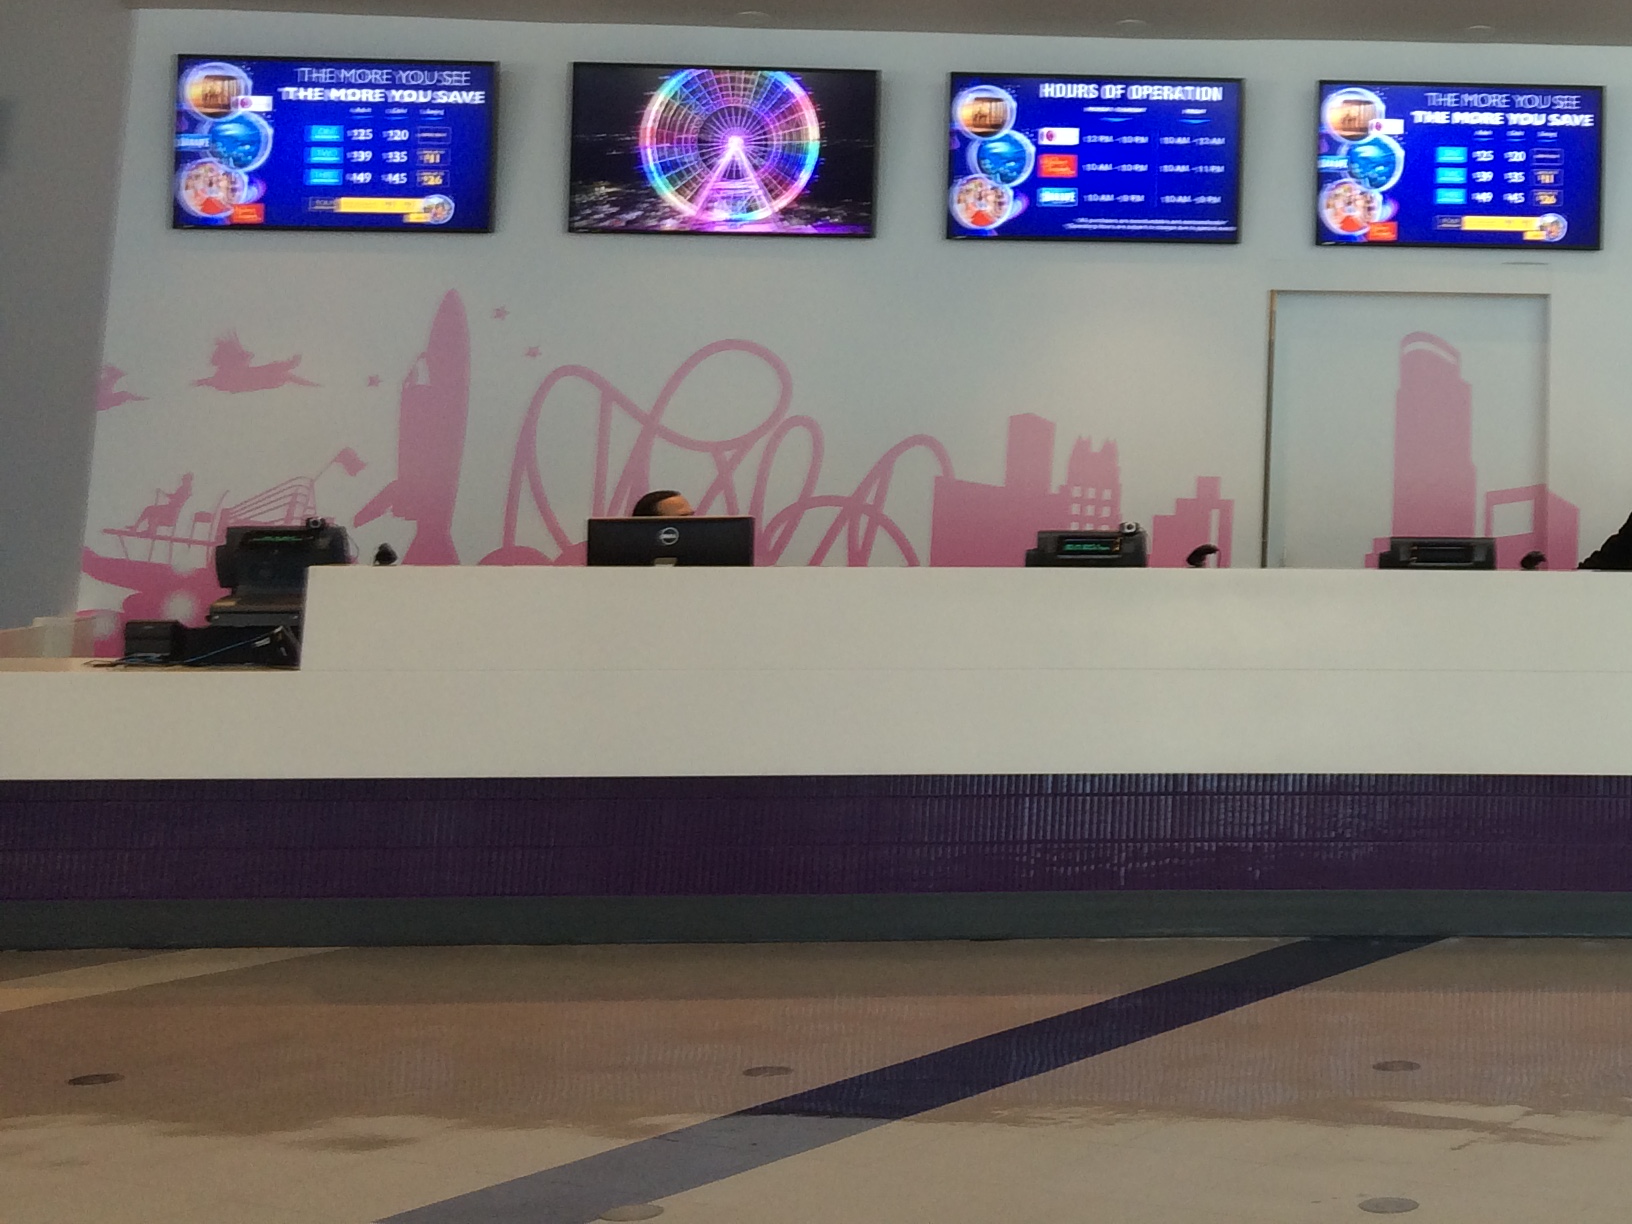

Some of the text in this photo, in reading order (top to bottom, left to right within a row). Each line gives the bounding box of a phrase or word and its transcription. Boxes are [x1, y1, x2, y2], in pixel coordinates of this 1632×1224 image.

[294, 68, 471, 85] THE MORE YOU SEE
[278, 87, 485, 104] THE MORE YOU SAVE
[1039, 83, 1224, 101] HOURS OF OPERATION
[1424, 92, 1581, 109] THE MORE YOU SEE
[1410, 110, 1594, 126] THE MORE YOU SAVE
